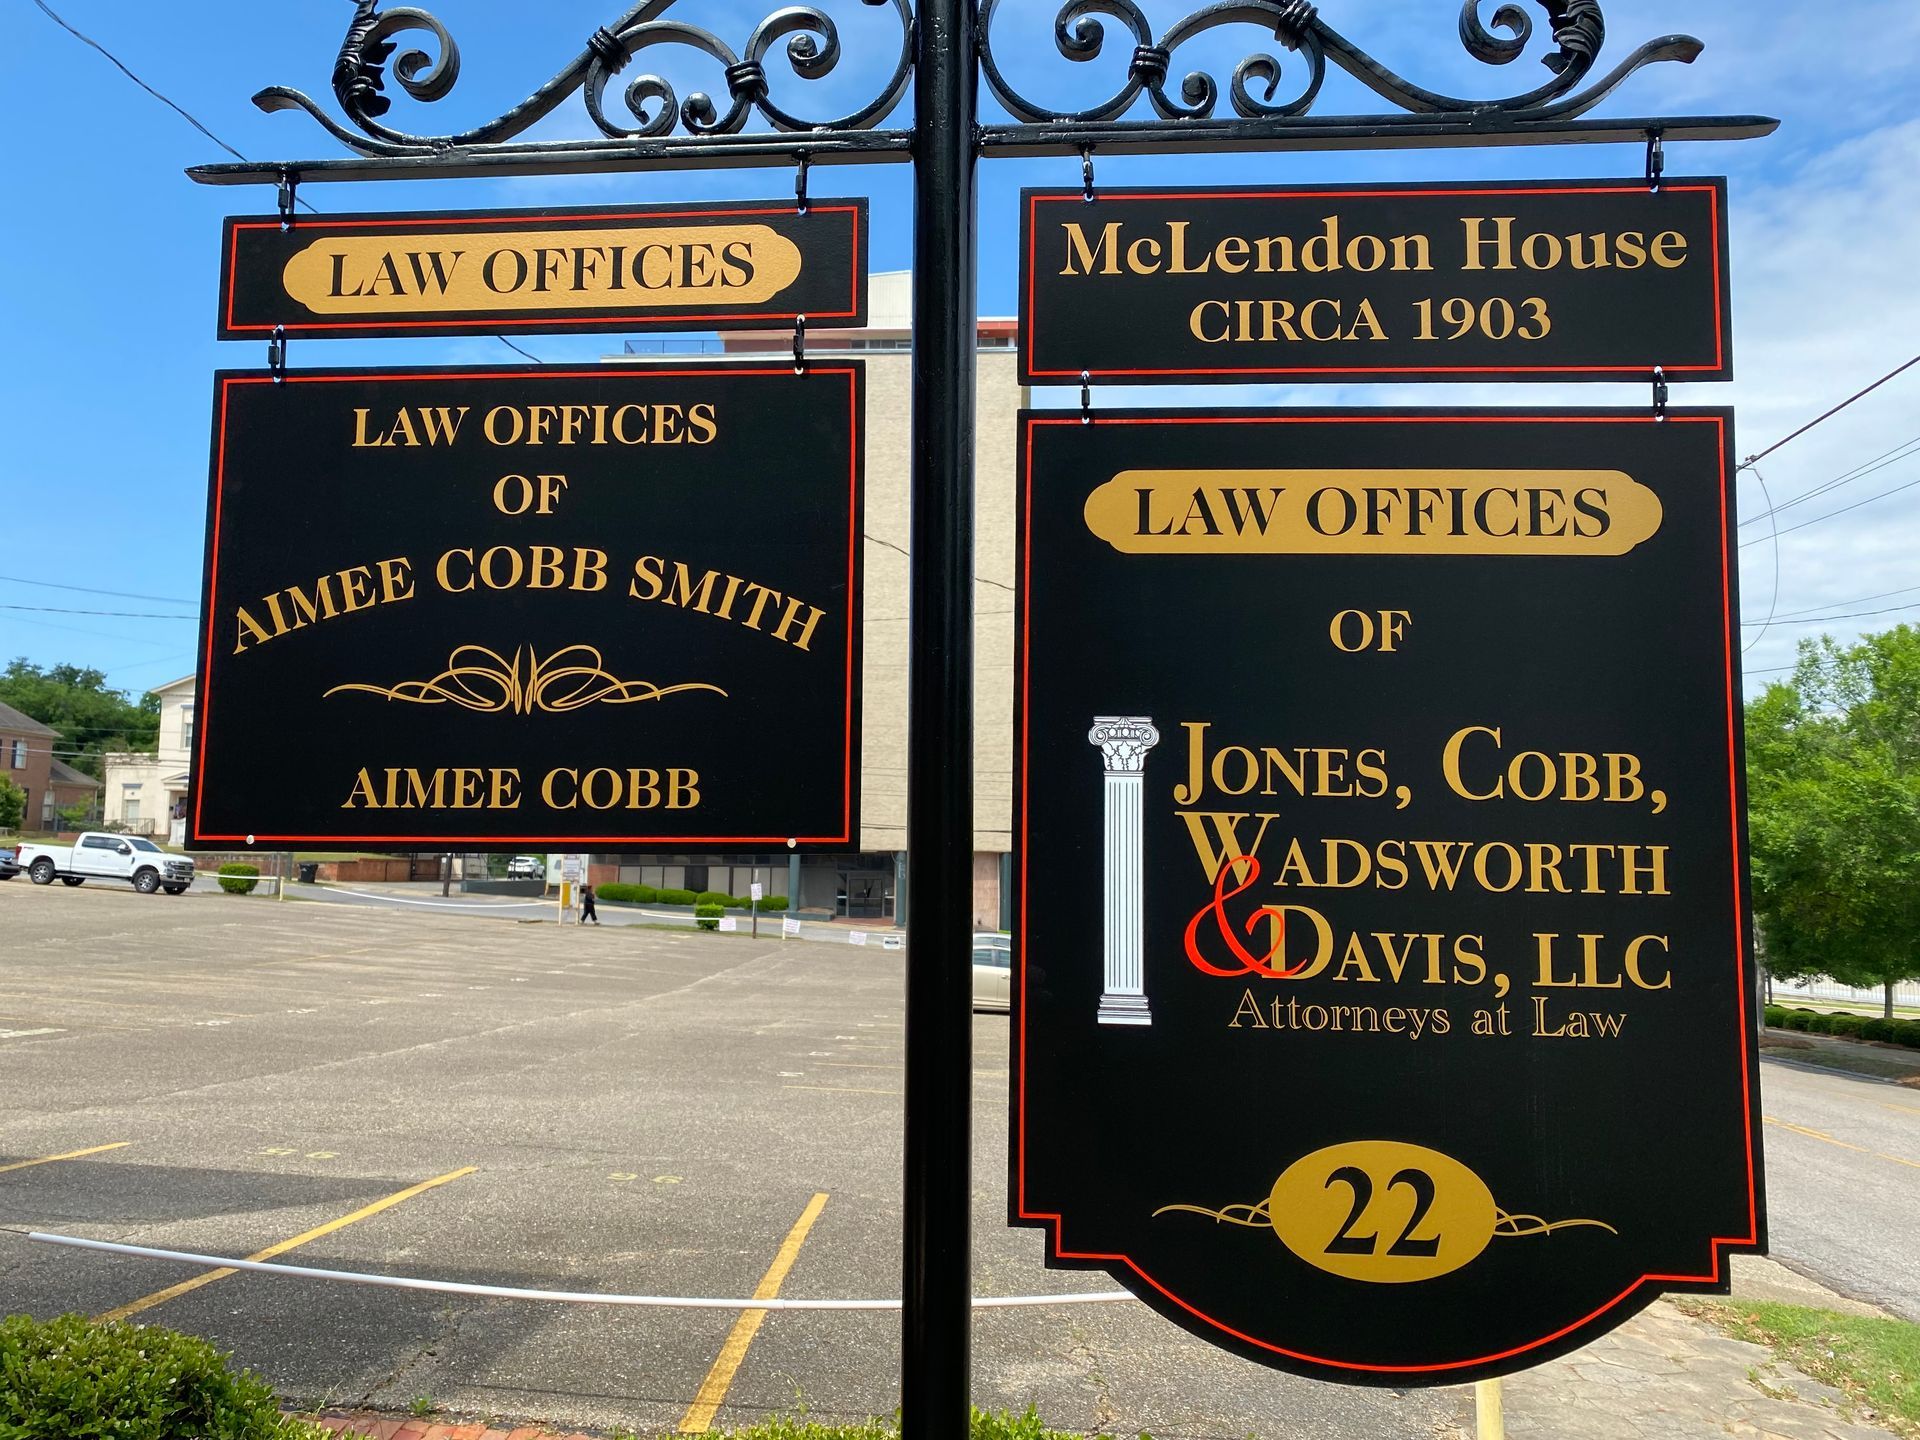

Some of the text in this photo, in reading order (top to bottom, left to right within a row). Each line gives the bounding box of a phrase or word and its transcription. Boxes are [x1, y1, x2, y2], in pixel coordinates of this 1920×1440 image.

[328, 242, 754, 296] LAW OFFICES
[1059, 215, 1687, 275] McLendon House
[1190, 298, 1550, 342] CIRCA 1903
[352, 404, 716, 446] LAW OFFICES
[494, 475, 568, 514] OF
[1134, 487, 1610, 537] LAW OFFICES
[233, 546, 826, 654] AIMEE COBB SMITH
[1330, 610, 1412, 652] OF
[341, 767, 700, 809] AIMEE COBB
[1532, 933, 1671, 989] LLC
[1228, 988, 1626, 1040] Attorneys at Law
[1324, 1167, 1441, 1257] 22
